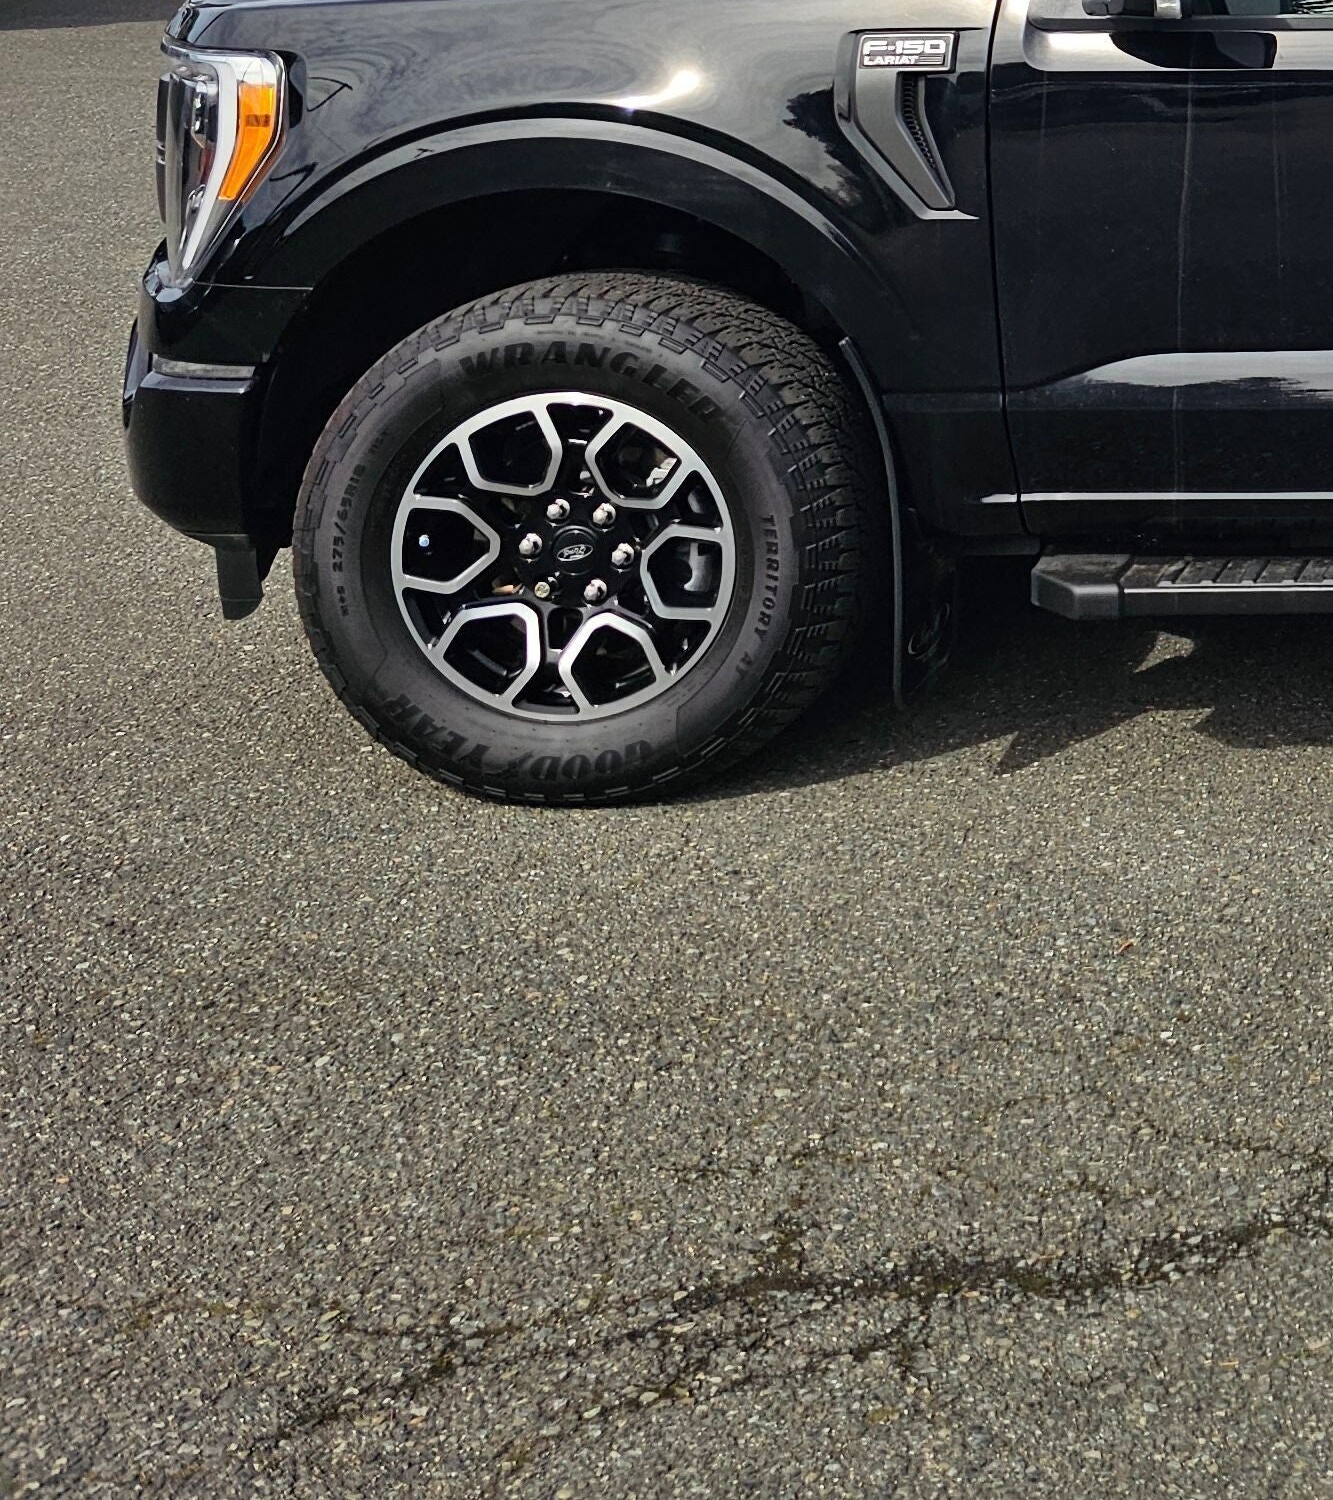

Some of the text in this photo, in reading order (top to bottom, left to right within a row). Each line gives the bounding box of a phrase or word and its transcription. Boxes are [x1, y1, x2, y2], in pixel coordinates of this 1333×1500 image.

[863, 40, 946, 55] F-150
[863, 55, 919, 66] LARIAT
[458, 341, 726, 421] WRANGLER
[755, 514, 780, 642] TERRITORY
[383, 693, 652, 781] GOODYEAR
